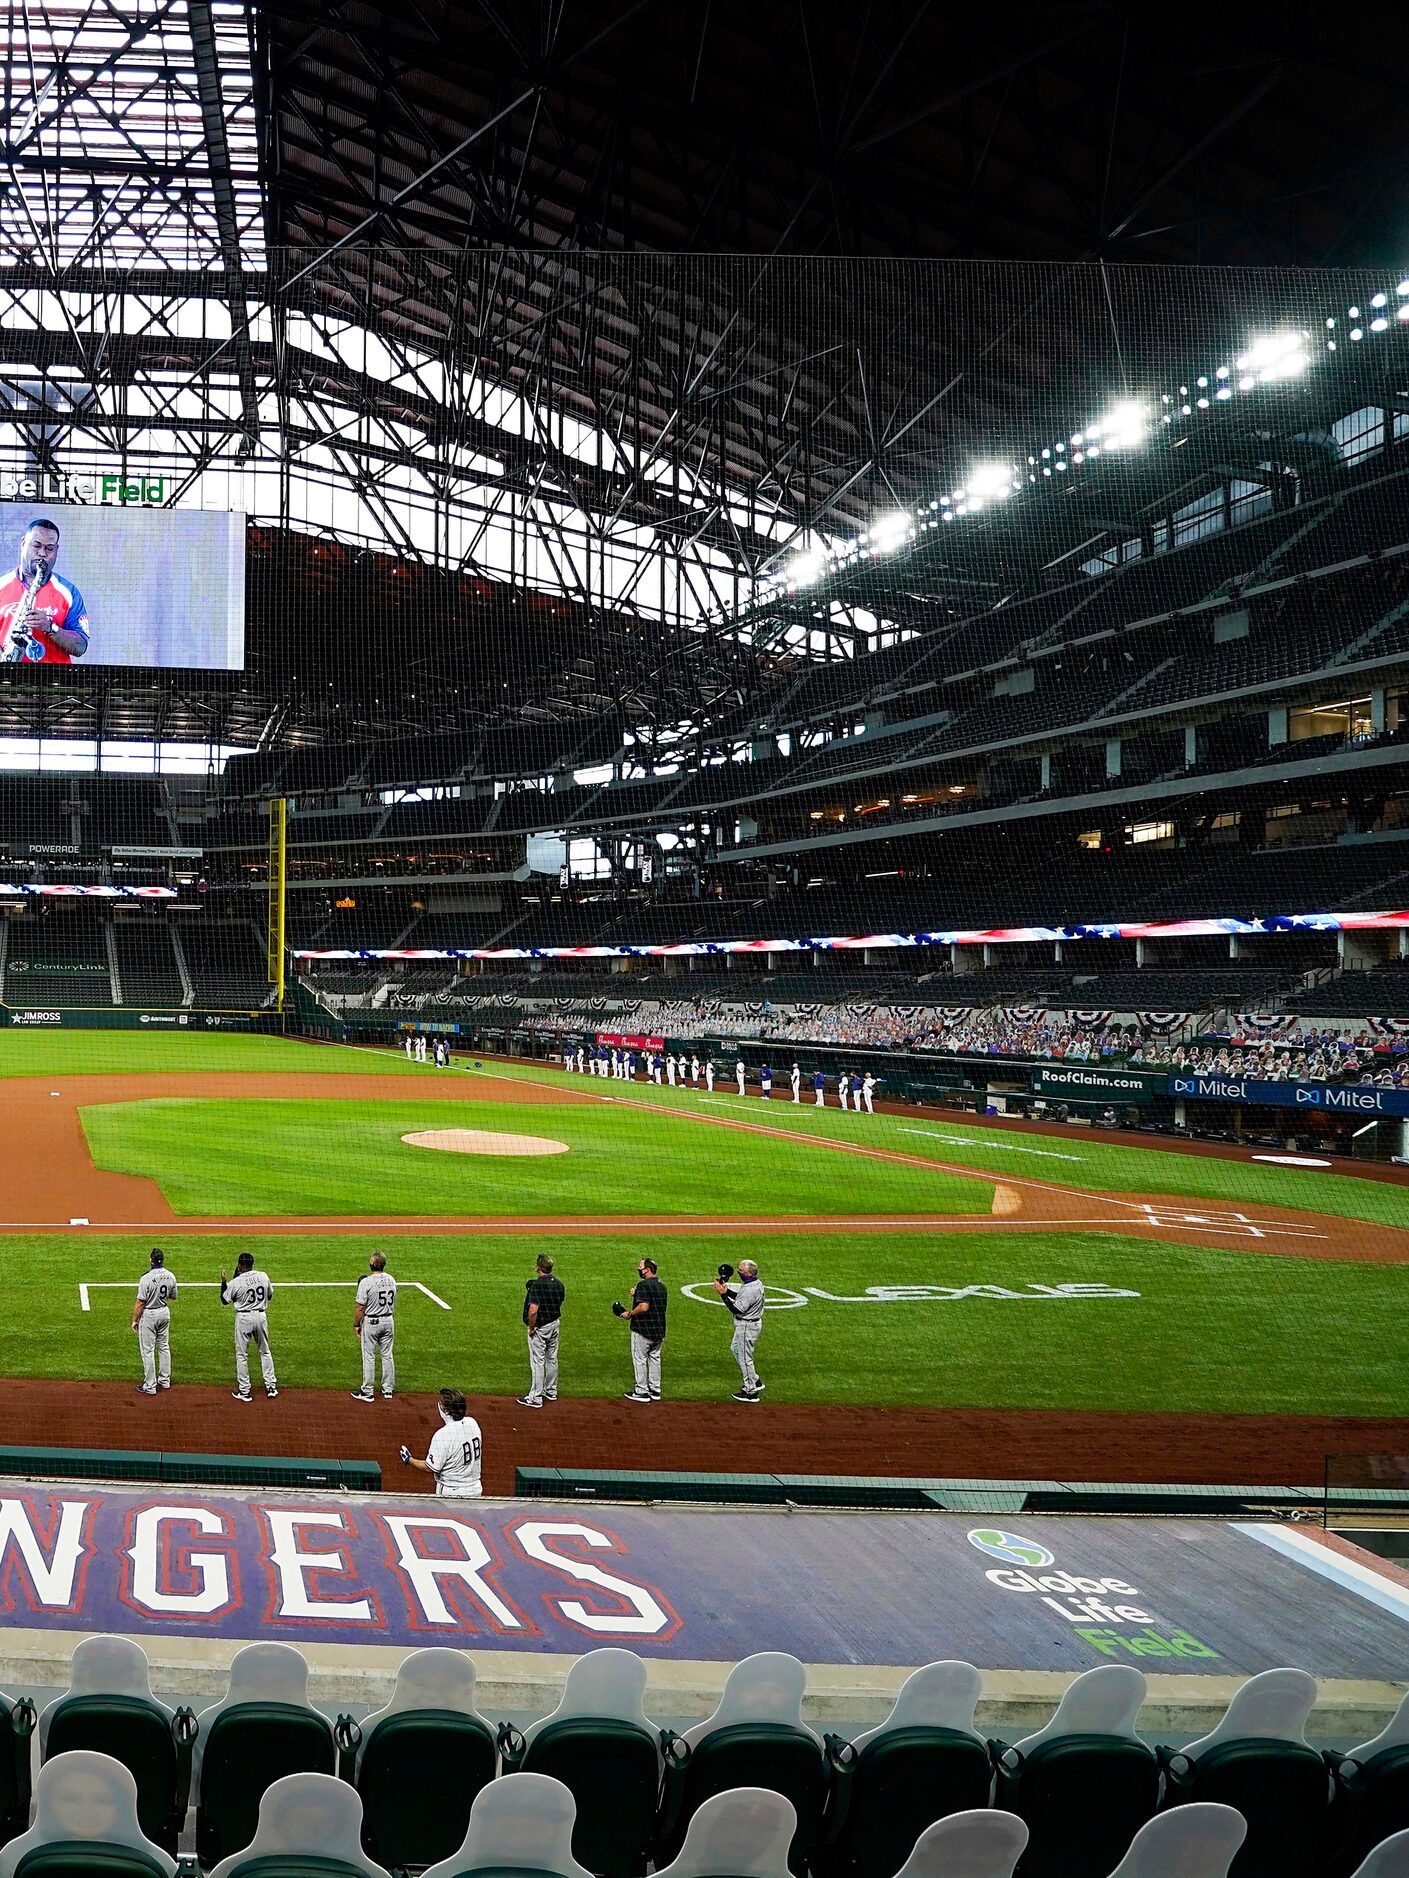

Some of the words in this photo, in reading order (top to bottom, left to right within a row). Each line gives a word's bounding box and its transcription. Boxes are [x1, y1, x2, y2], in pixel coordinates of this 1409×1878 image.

[42, 473, 95, 502] Life
[101, 475, 165, 505] Field
[29, 845, 79, 853] POWERADE
[33, 963, 105, 972] CenturyLink
[1042, 1070, 1143, 1089] RoofClaim.com
[1199, 1079, 1246, 1098] Mitel
[1325, 1089, 1383, 1110] Mitel
[159, 1284, 168, 1300] 9
[246, 1285, 265, 1304] 39
[378, 1290, 395, 1307] 53
[802, 1282, 1142, 1302] LEXUS
[984, 1568, 1140, 1595] Globe
[1040, 1596, 1155, 1624] Life
[1073, 1627, 1221, 1658] Field
